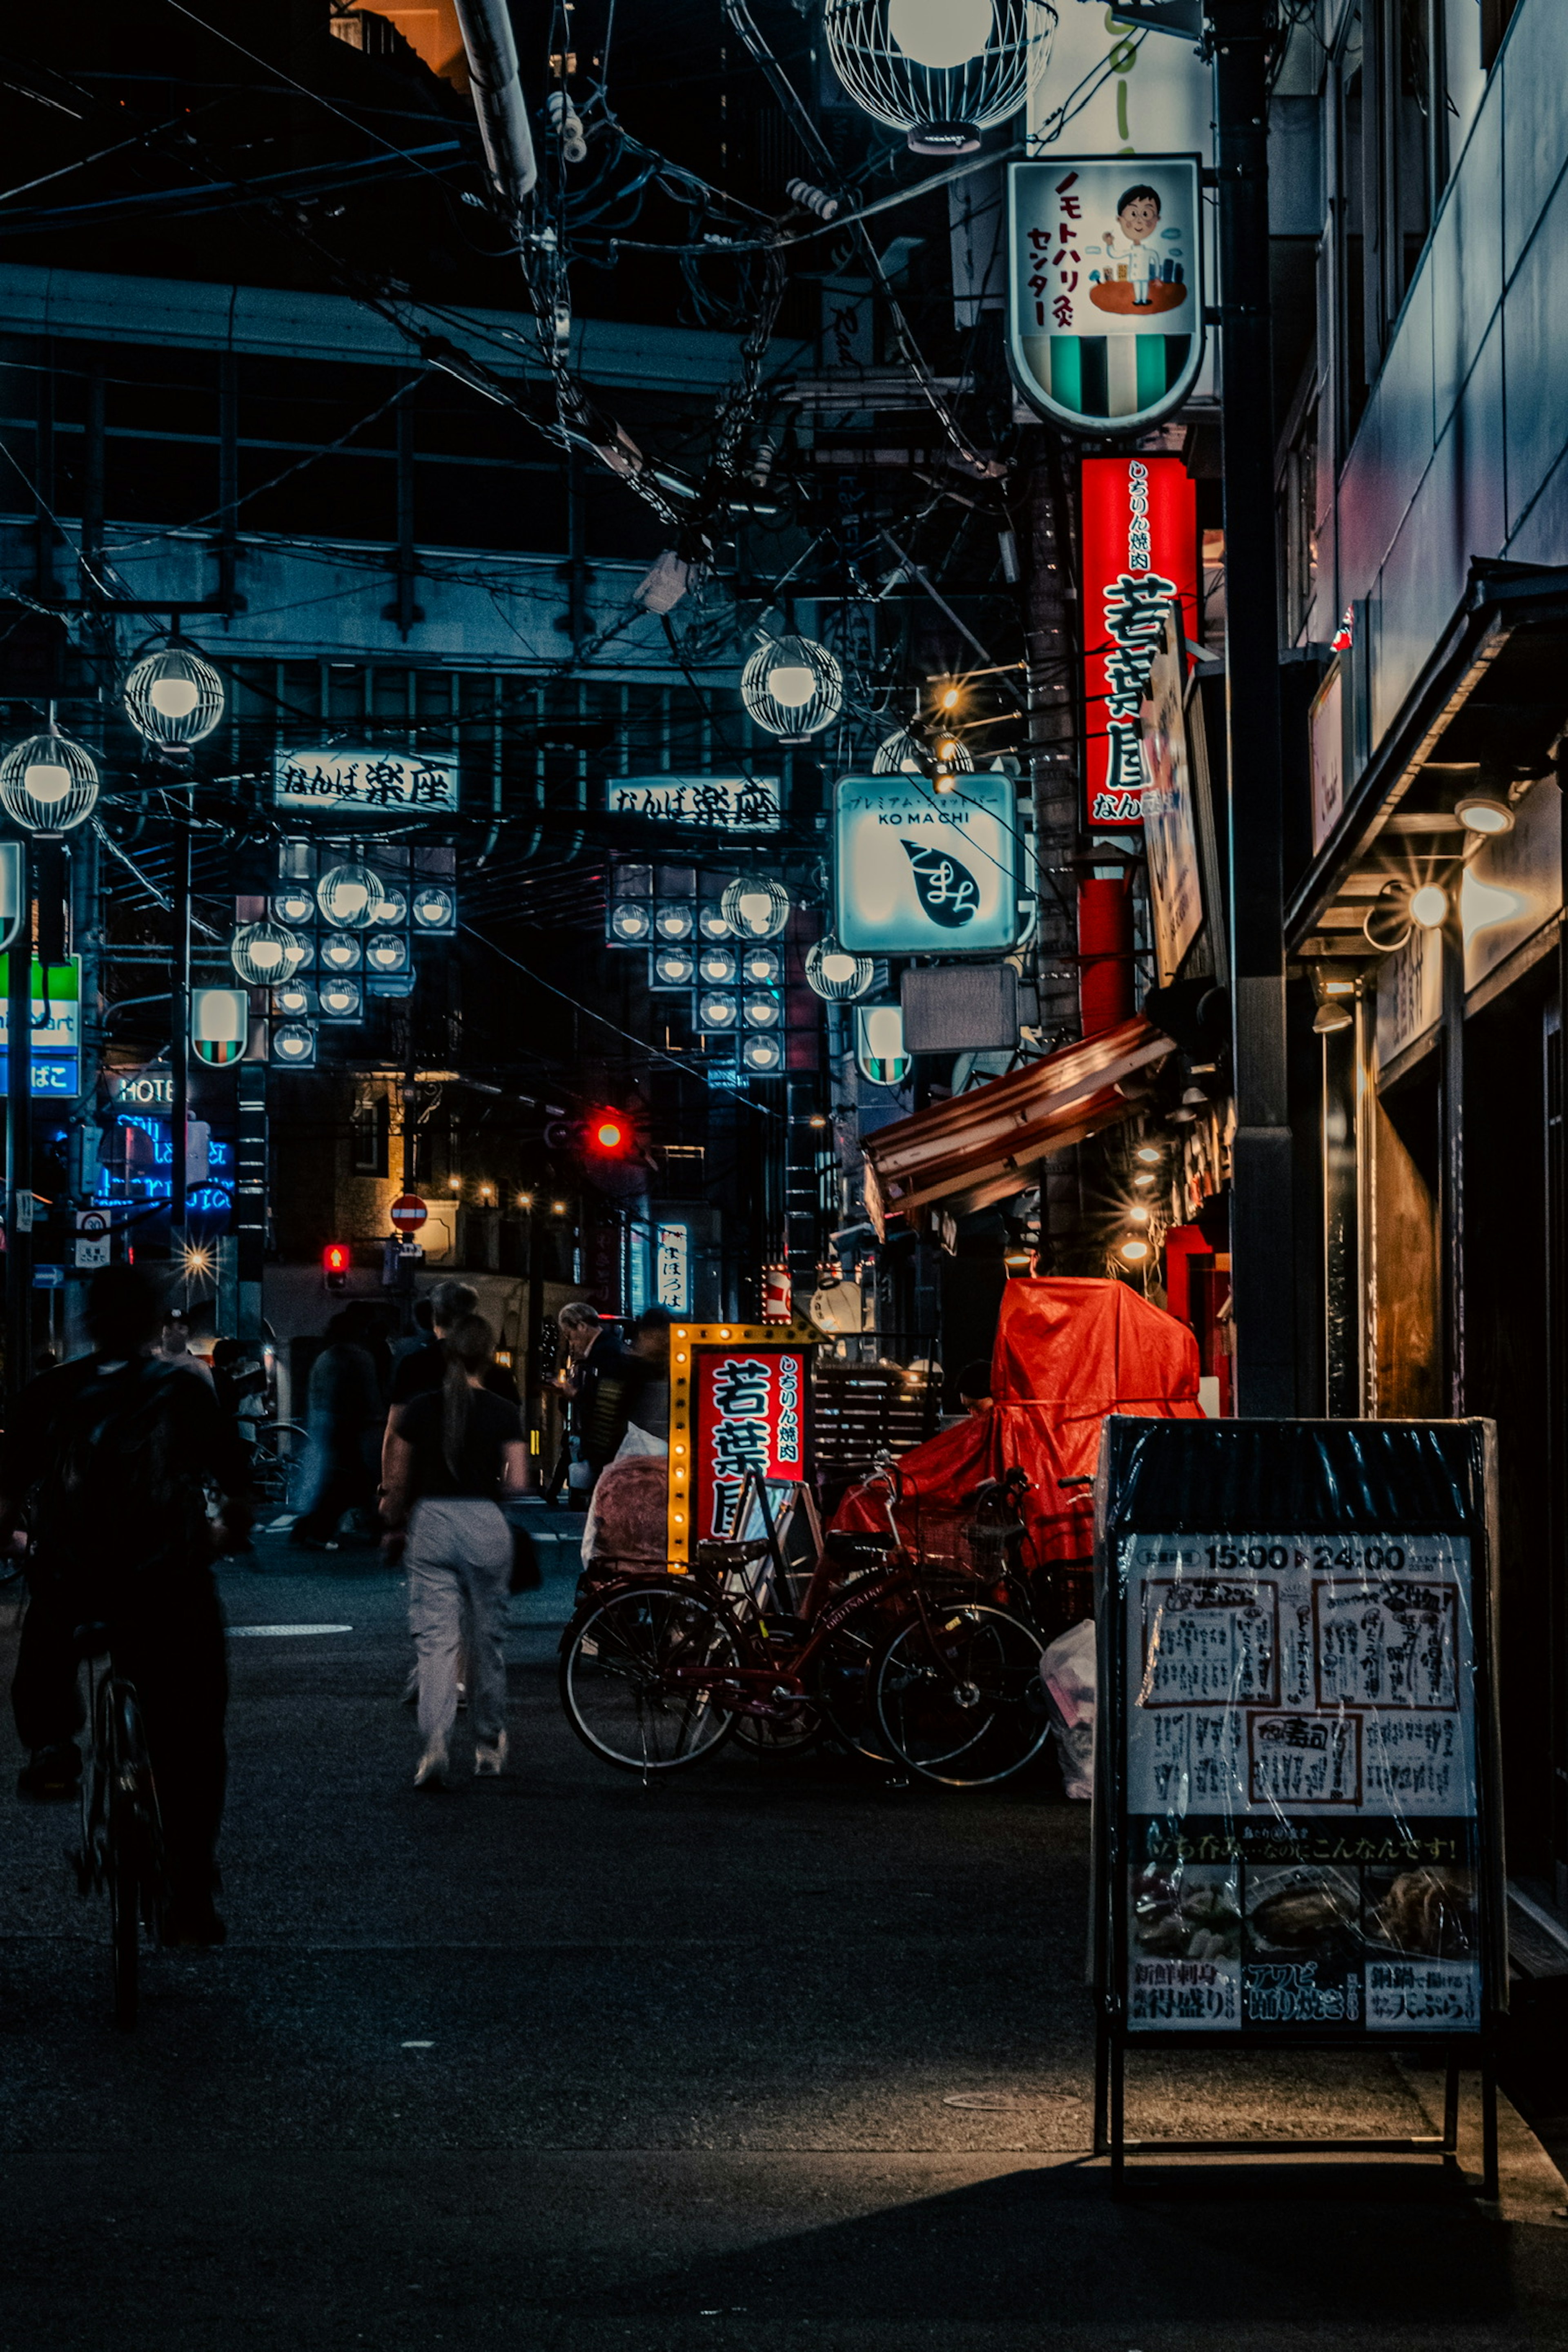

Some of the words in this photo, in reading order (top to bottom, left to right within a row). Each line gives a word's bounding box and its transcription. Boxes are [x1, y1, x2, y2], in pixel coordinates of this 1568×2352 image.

[1052, 171, 1082, 327] ノモトハリ灸
[1027, 227, 1052, 326] センター
[1128, 460, 1151, 571] しちりん焼肉
[285, 761, 449, 804] なんば楽座
[616, 784, 771, 824] なんば楽座
[31, 1065, 67, 1087] ばこ
[662, 1247, 682, 1307] まほろば
[778, 1355, 799, 1463] しちりん焼肉
[1206, 1545, 1288, 1569] 15:00
[1314, 1546, 1405, 1570] 24:00
[1247, 1960, 1319, 1990] アワビ
[1390, 1992, 1463, 2020] 天ぷら
